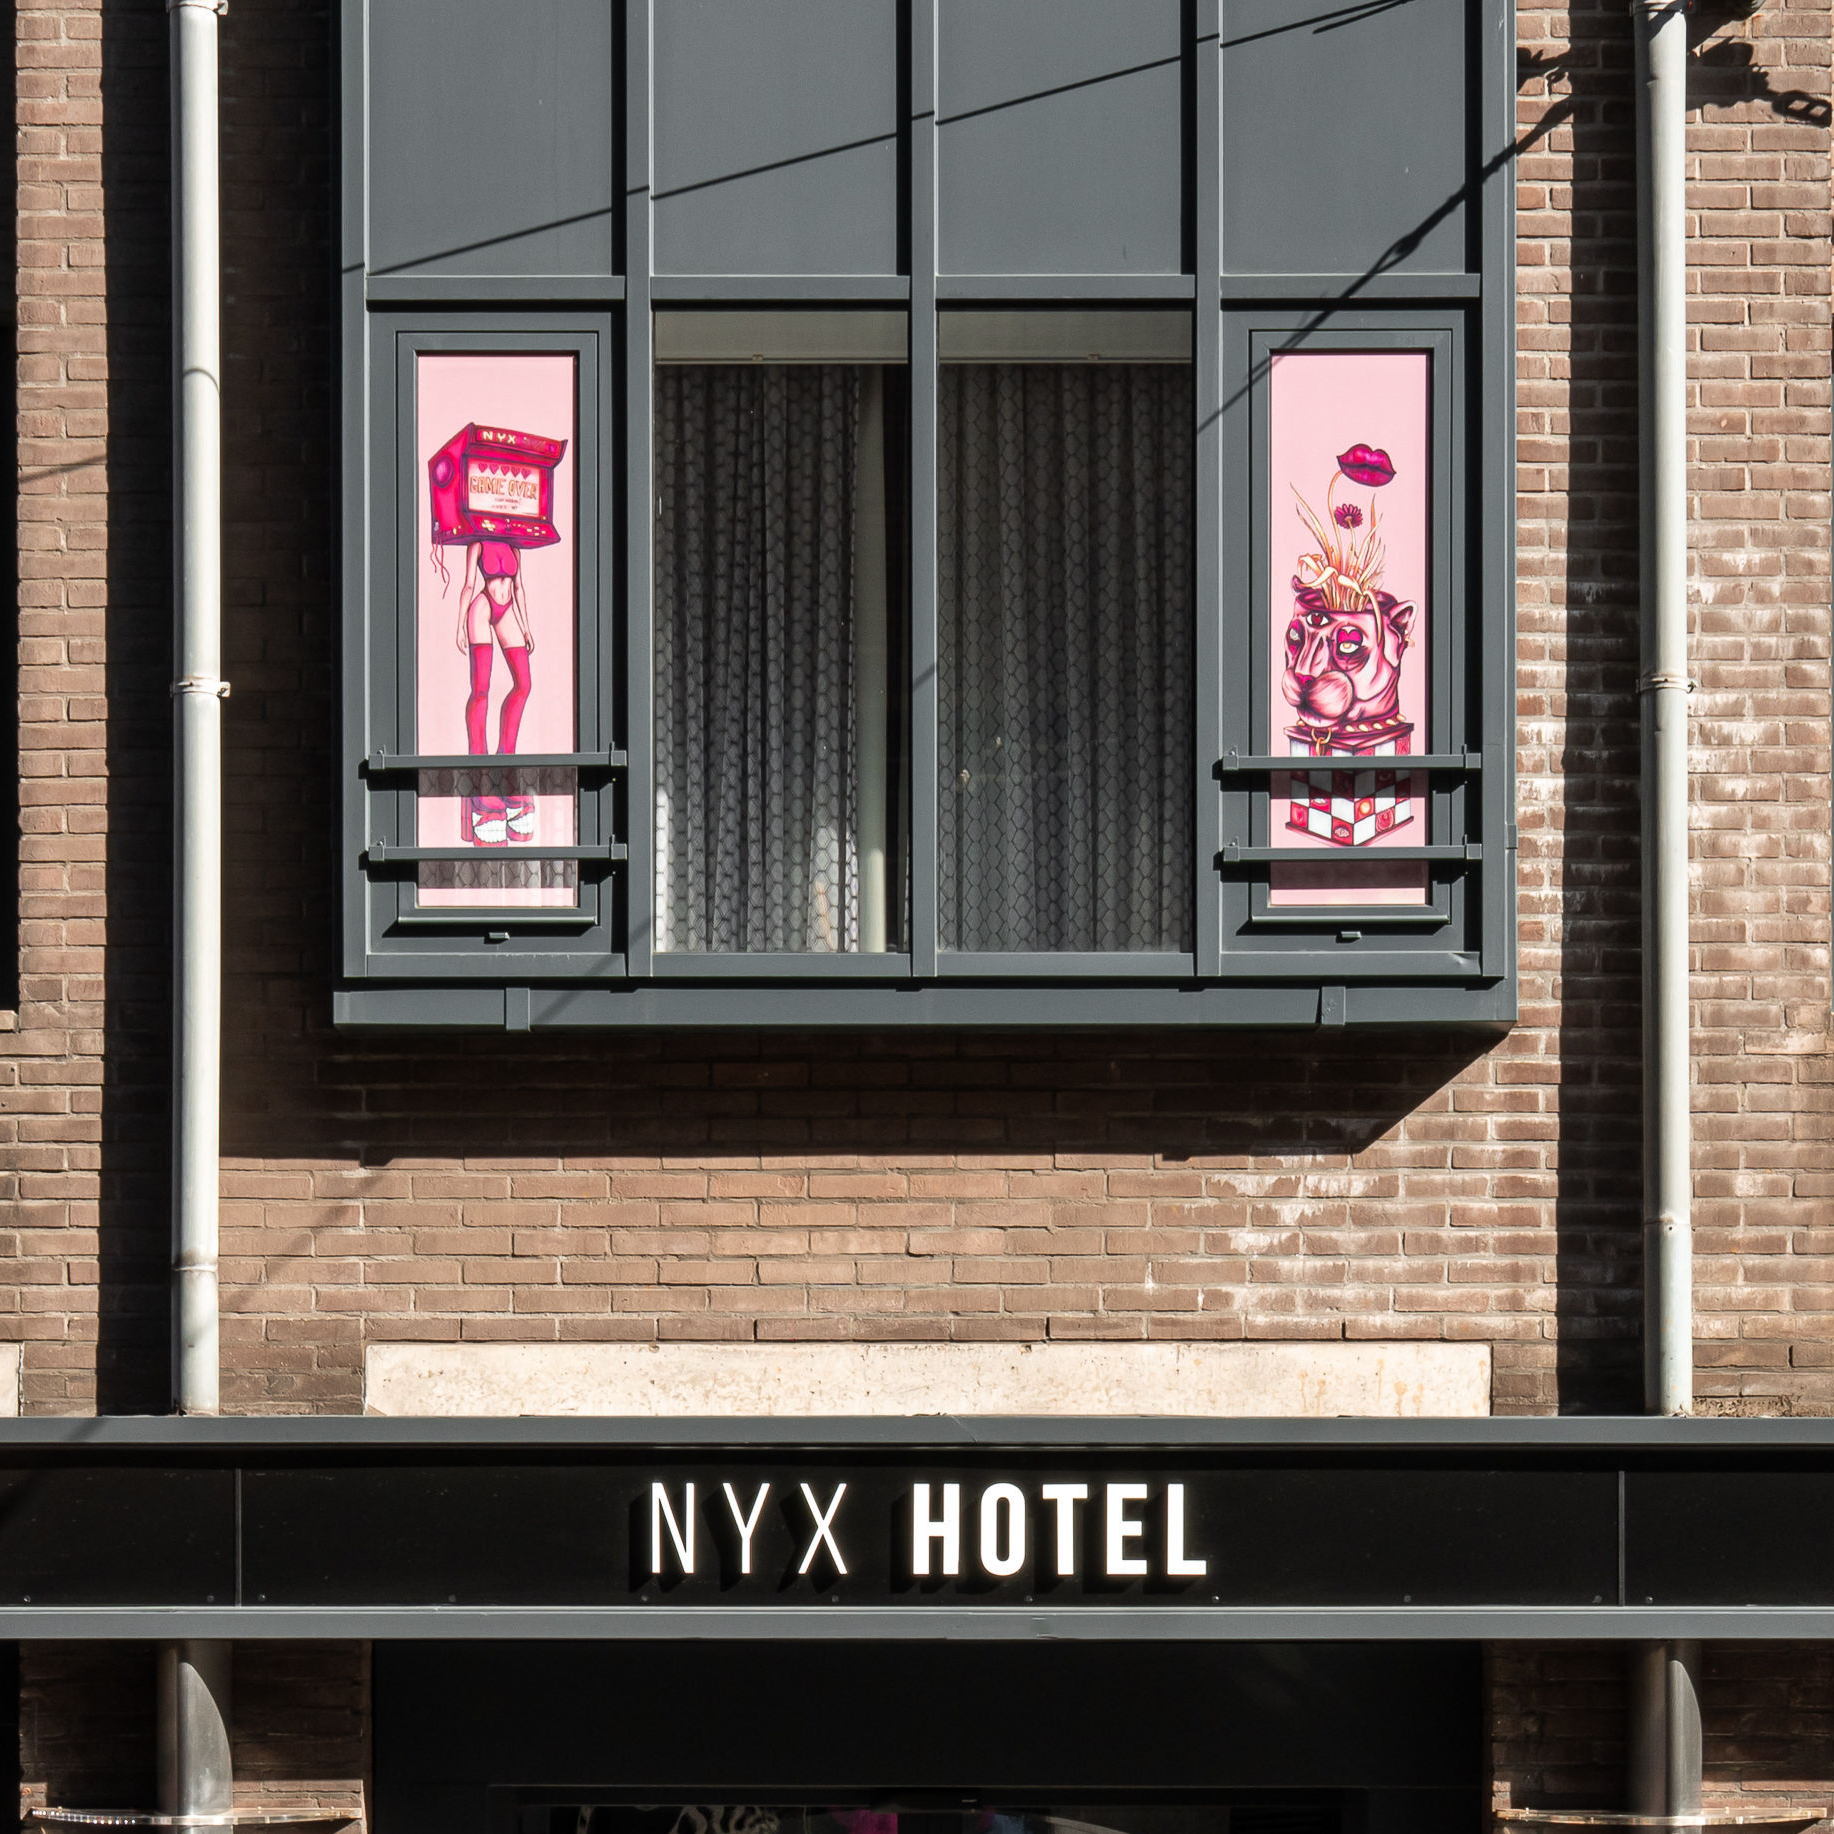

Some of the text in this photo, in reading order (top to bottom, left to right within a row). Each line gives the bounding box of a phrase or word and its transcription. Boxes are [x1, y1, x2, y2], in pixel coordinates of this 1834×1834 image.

[481, 430, 516, 445] NYX
[470, 476, 537, 501] GAME OVER
[650, 1482, 1208, 1577] NYX HOTEL
